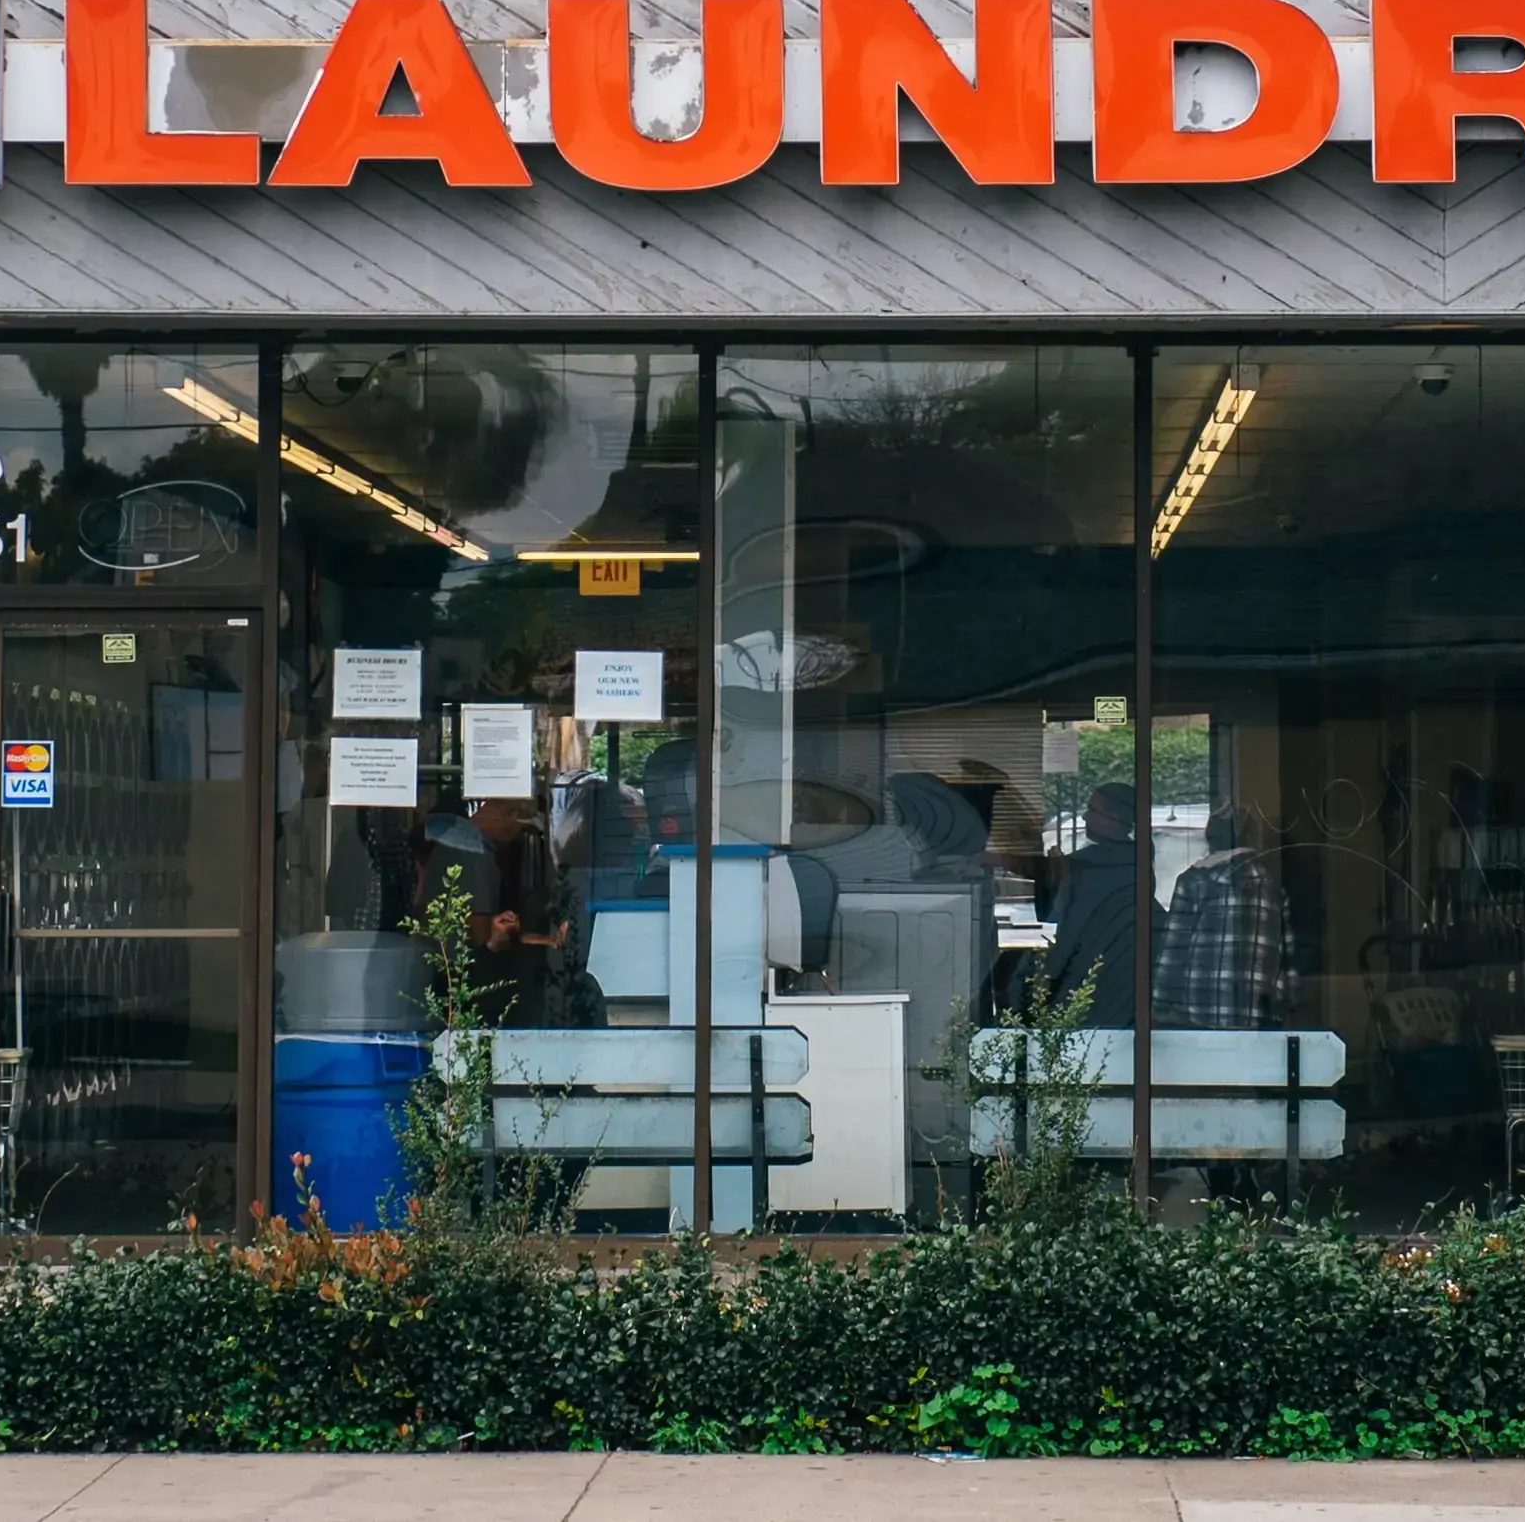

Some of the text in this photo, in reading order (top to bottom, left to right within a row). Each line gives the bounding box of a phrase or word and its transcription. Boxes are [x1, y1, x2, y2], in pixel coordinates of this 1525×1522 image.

[592, 559, 628, 582] EXIT
[604, 664, 634, 673] ENJOY
[618, 677, 640, 685] NEW
[10, 779, 48, 793] VISA
